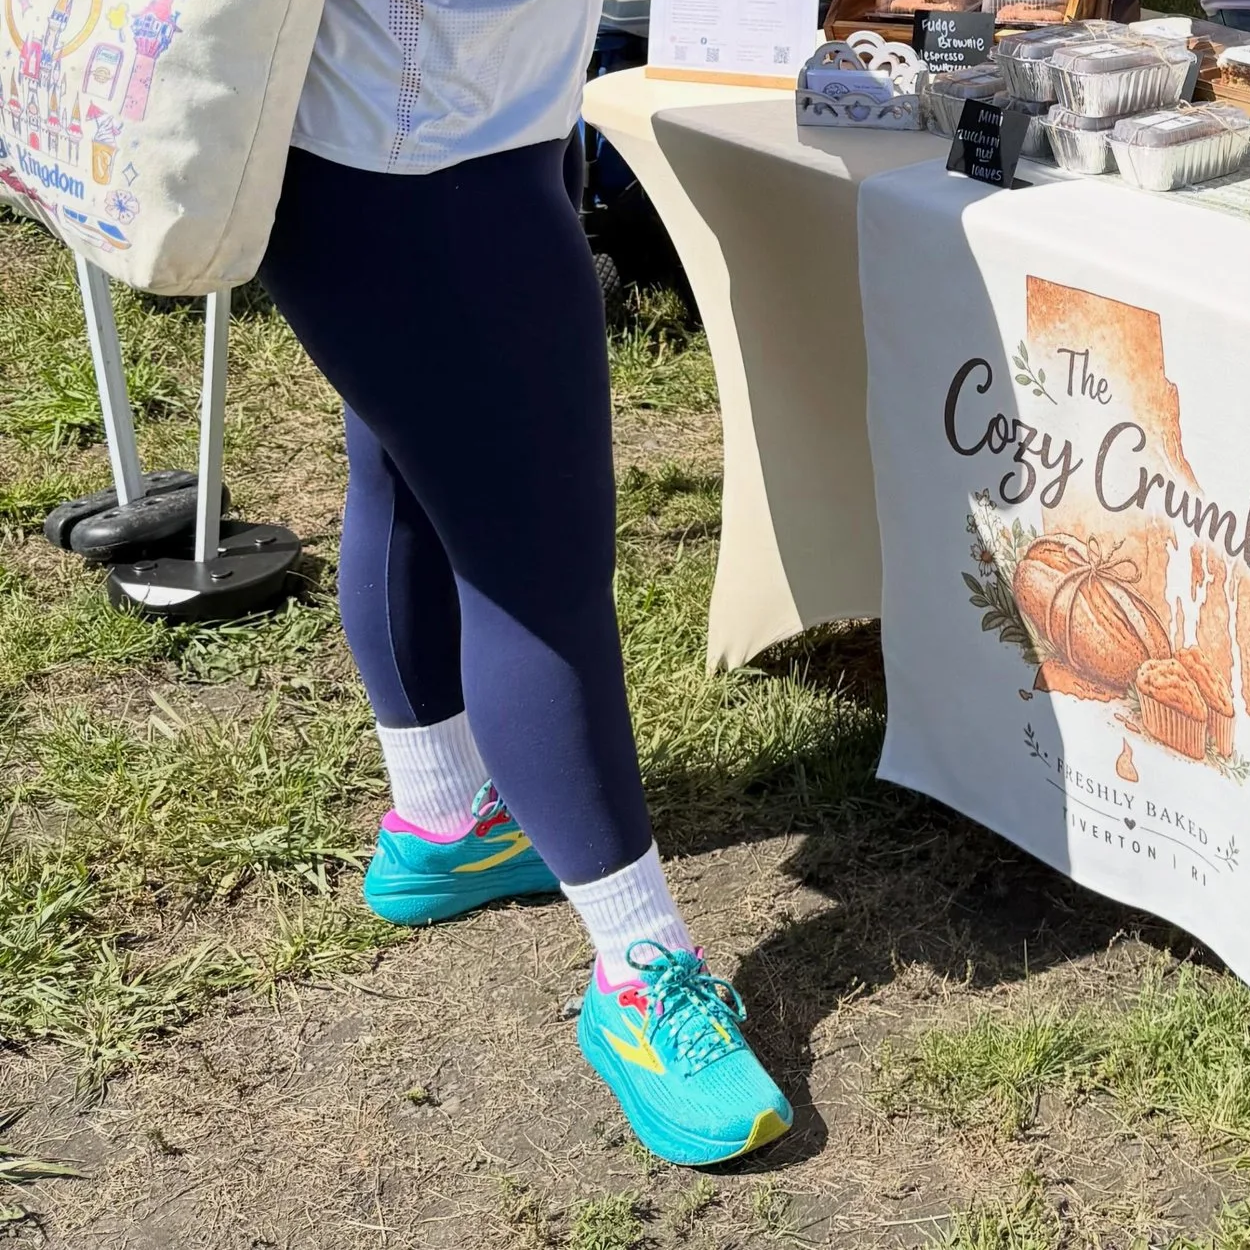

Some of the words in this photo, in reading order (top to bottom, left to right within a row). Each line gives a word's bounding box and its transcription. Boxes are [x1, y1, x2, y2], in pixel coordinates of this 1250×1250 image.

[922, 18, 956, 38] Fudge
[938, 35, 985, 51] Brownie
[924, 51, 964, 62] espresso
[978, 109, 1004, 127] Mini
[975, 147, 994, 159] nut
[16, 143, 85, 200] Kingdom
[971, 163, 1003, 181] loaves
[1056, 347, 1112, 406] The
[943, 356, 1084, 510] Cozy
[1057, 757, 1135, 810] FRESHLY
[1146, 800, 1208, 846] BAKED
[1062, 805, 1157, 860] TIVERTON
[1191, 865, 1207, 887] RI
